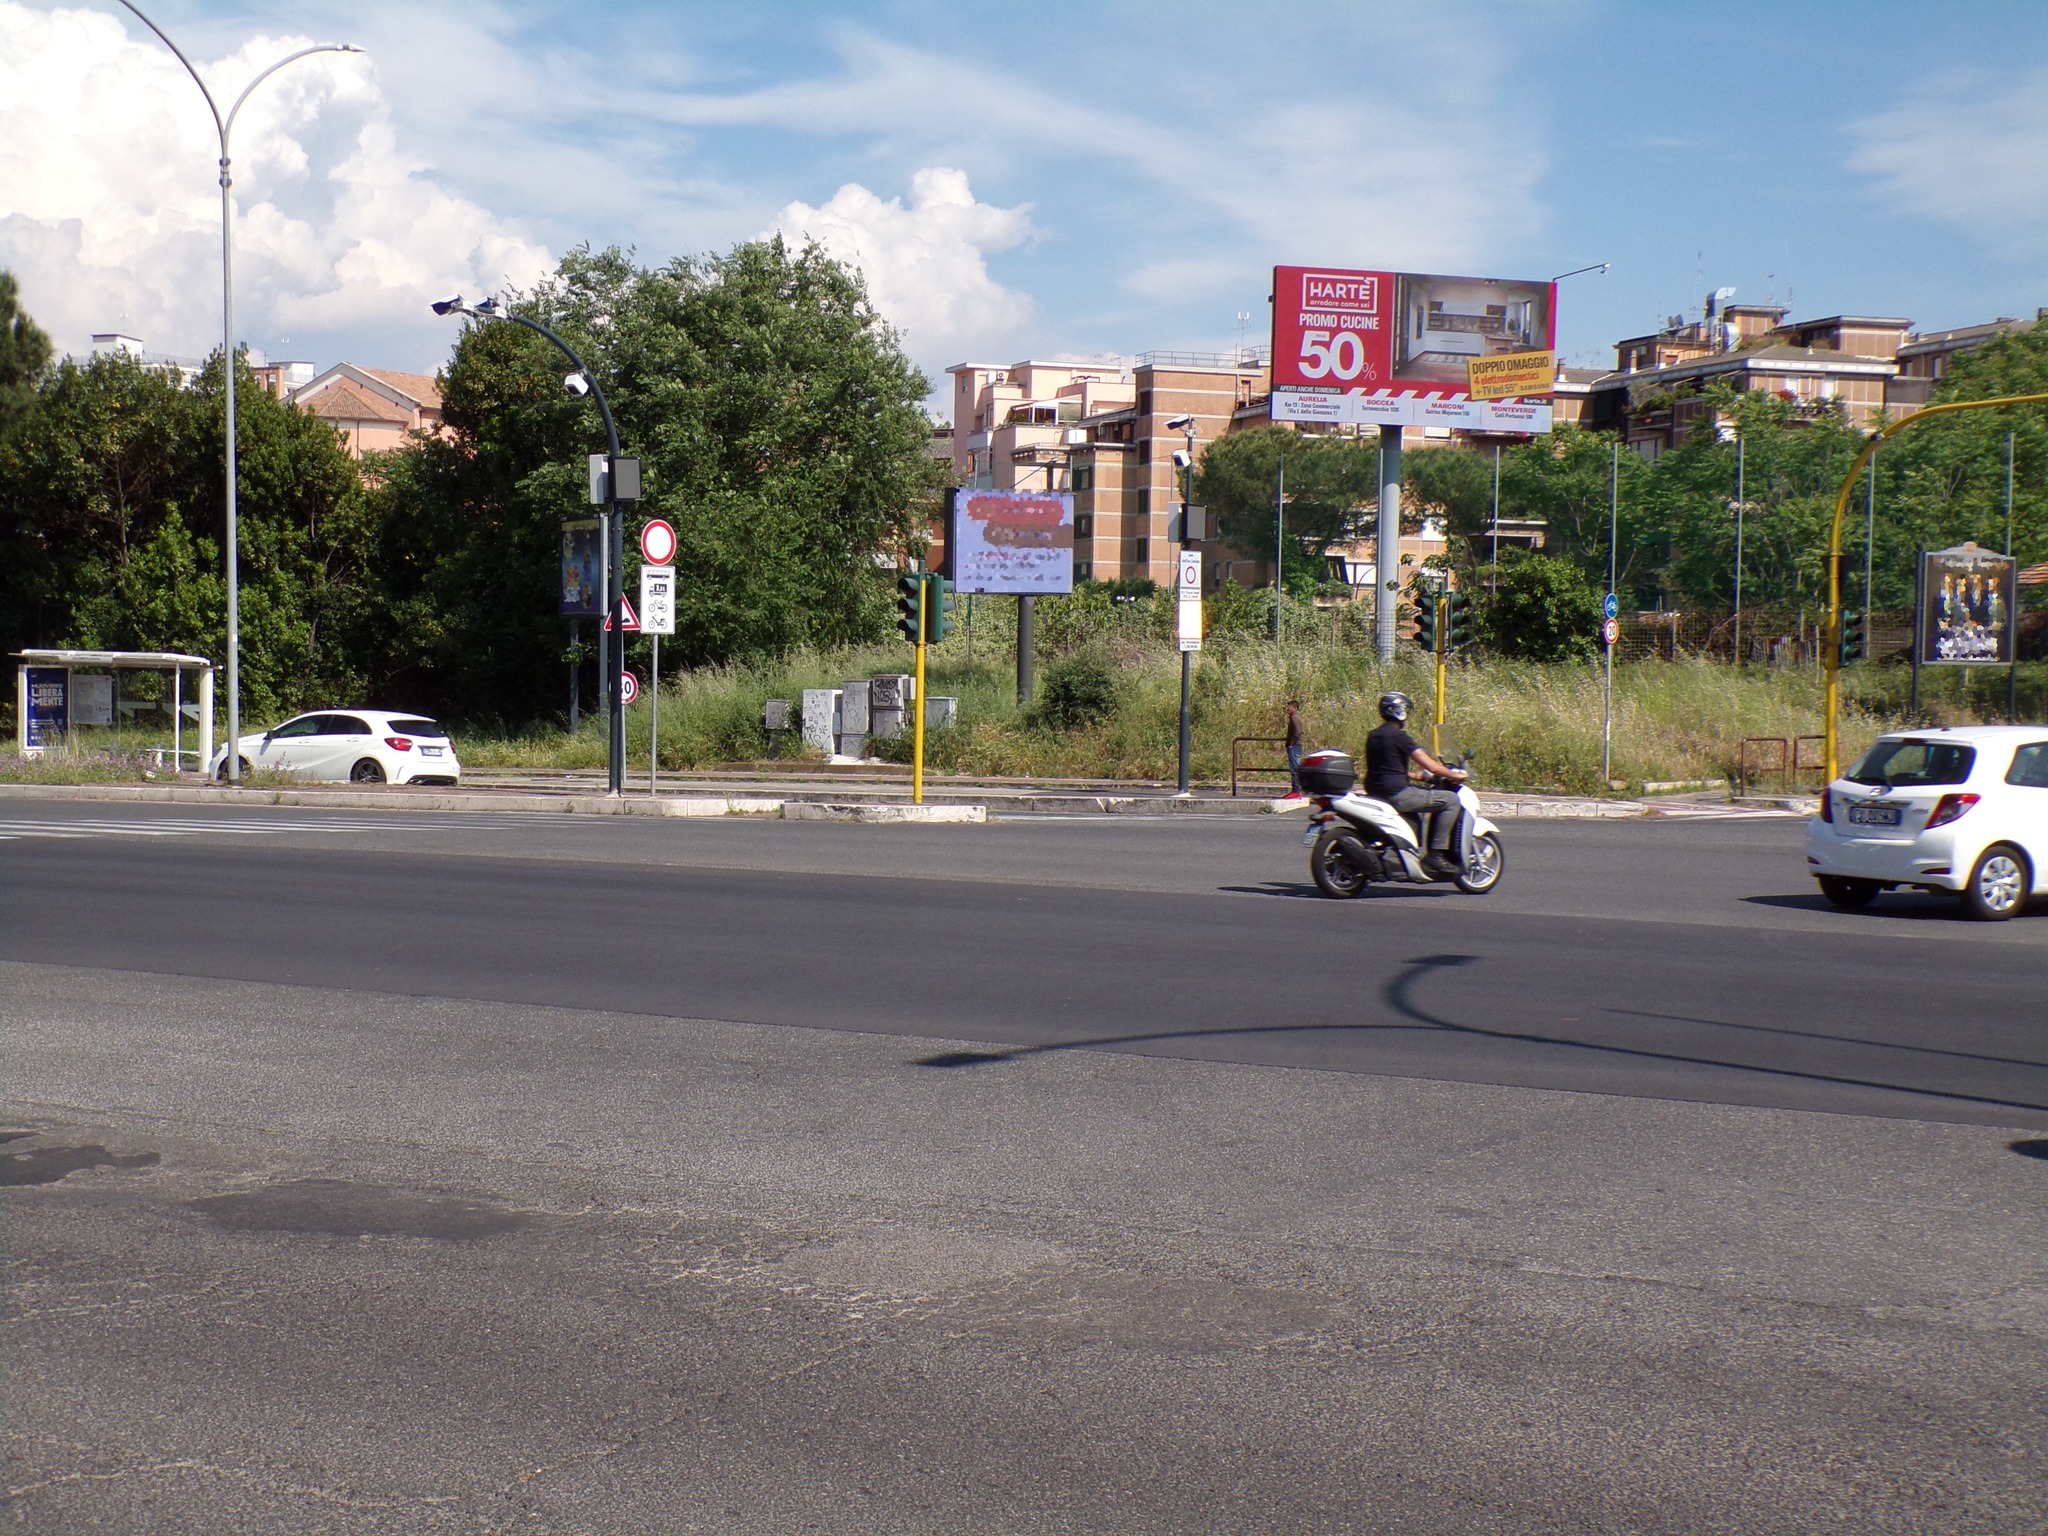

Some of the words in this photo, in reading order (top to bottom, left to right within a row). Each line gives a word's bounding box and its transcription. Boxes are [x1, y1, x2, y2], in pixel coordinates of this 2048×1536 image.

[1299, 313, 1338, 327] PROMO
[1340, 315, 1380, 330] CUCINE
[1298, 330, 1377, 381] 50%
[1472, 360, 1506, 375] DOPPIO
[1506, 356, 1549, 372] OMAGGIO
[1474, 376, 1480, 385] 4
[1481, 370, 1540, 385] elettrodomestici
[1314, 386, 1341, 394] DOMENICA
[1493, 385, 1504, 394] led
[1520, 383, 1550, 391] SAMSUNG
[1297, 395, 1328, 403] AURELIA
[1431, 402, 1464, 410] MARCONI
[1491, 405, 1537, 414] MONTEVERDE
[1609, 625, 1615, 637] 20
[31, 688, 63, 697] LIBERA
[31, 697, 63, 707] MENTE
